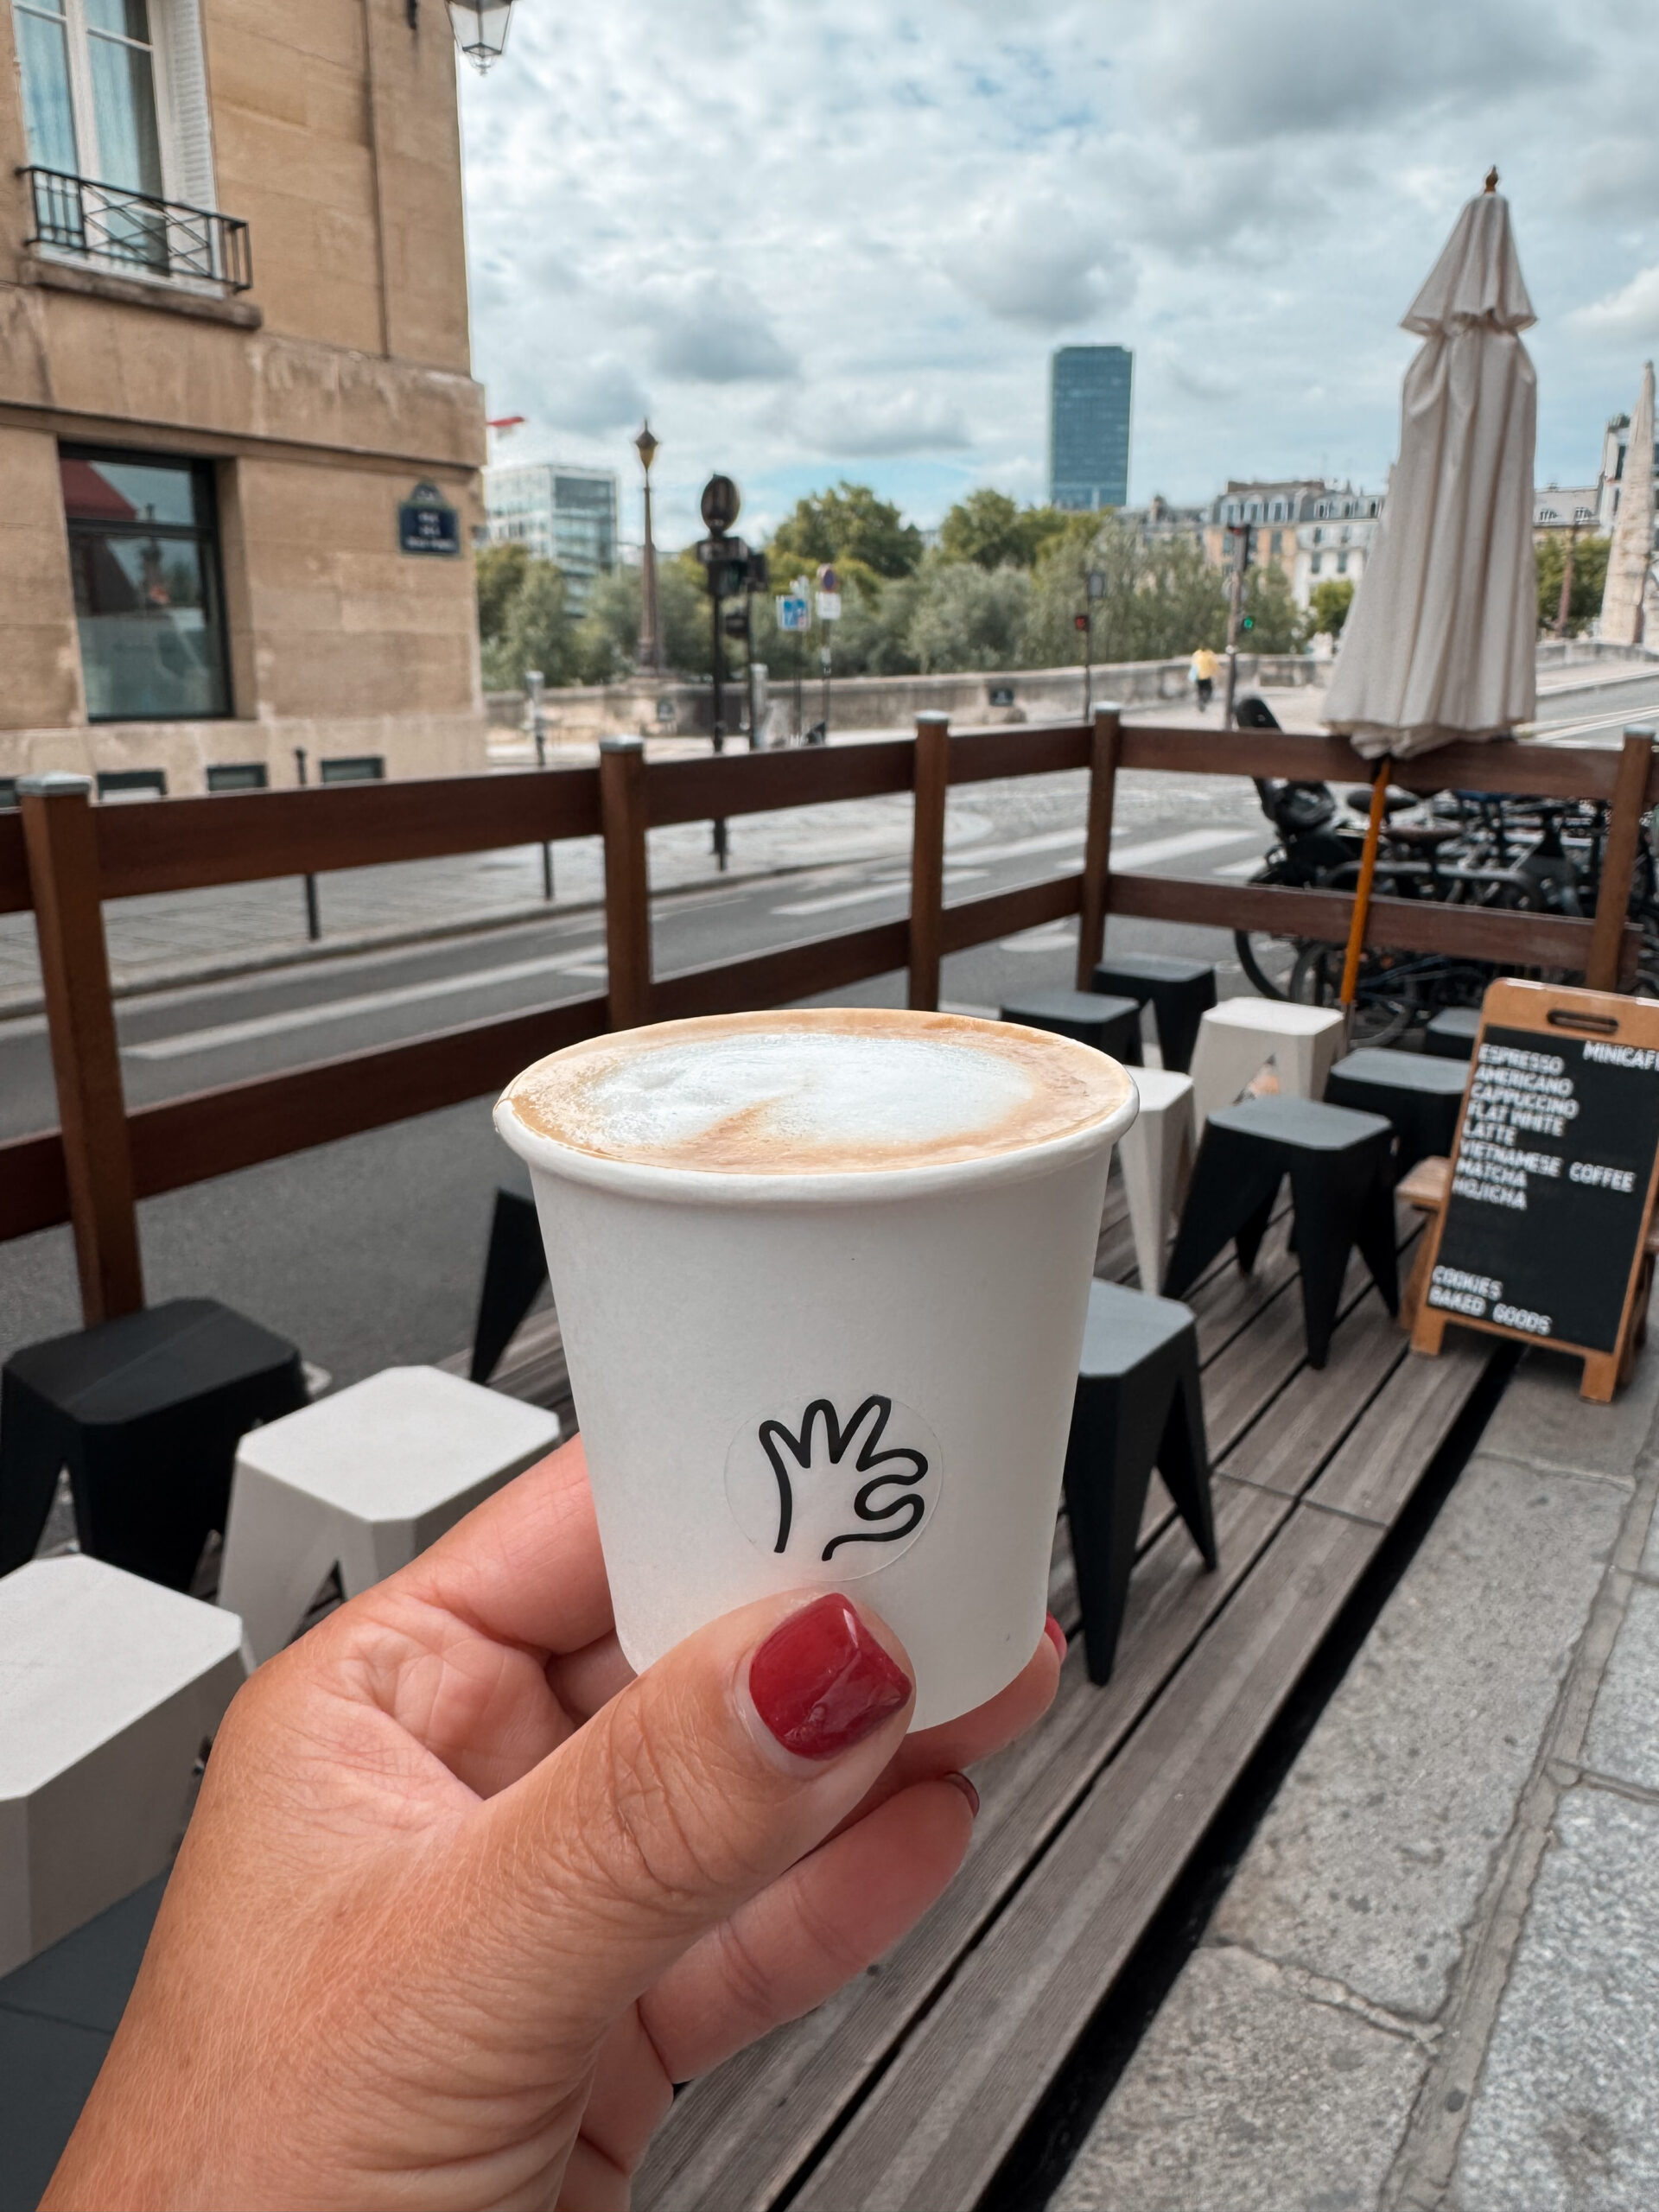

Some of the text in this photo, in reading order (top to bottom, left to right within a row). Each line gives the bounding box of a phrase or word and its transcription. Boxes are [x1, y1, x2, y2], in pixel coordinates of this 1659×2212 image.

[1478, 1043, 1565, 1076] ESPRESSO
[1474, 1064, 1573, 1097] AMERICANO
[1466, 1099, 1566, 1137] FLAT WHITE
[1471, 1082, 1580, 1120] CAPPUCCINO
[1462, 1119, 1517, 1146] LATTE
[1456, 1157, 1528, 1188] MATCHA
[1460, 1138, 1637, 1192] VIETNAMESE COFFEE
[1452, 1176, 1528, 1211] HOJICHA
[1432, 1265, 1503, 1300] COOKIES
[1428, 1285, 1553, 1336] BAKED GOODS
